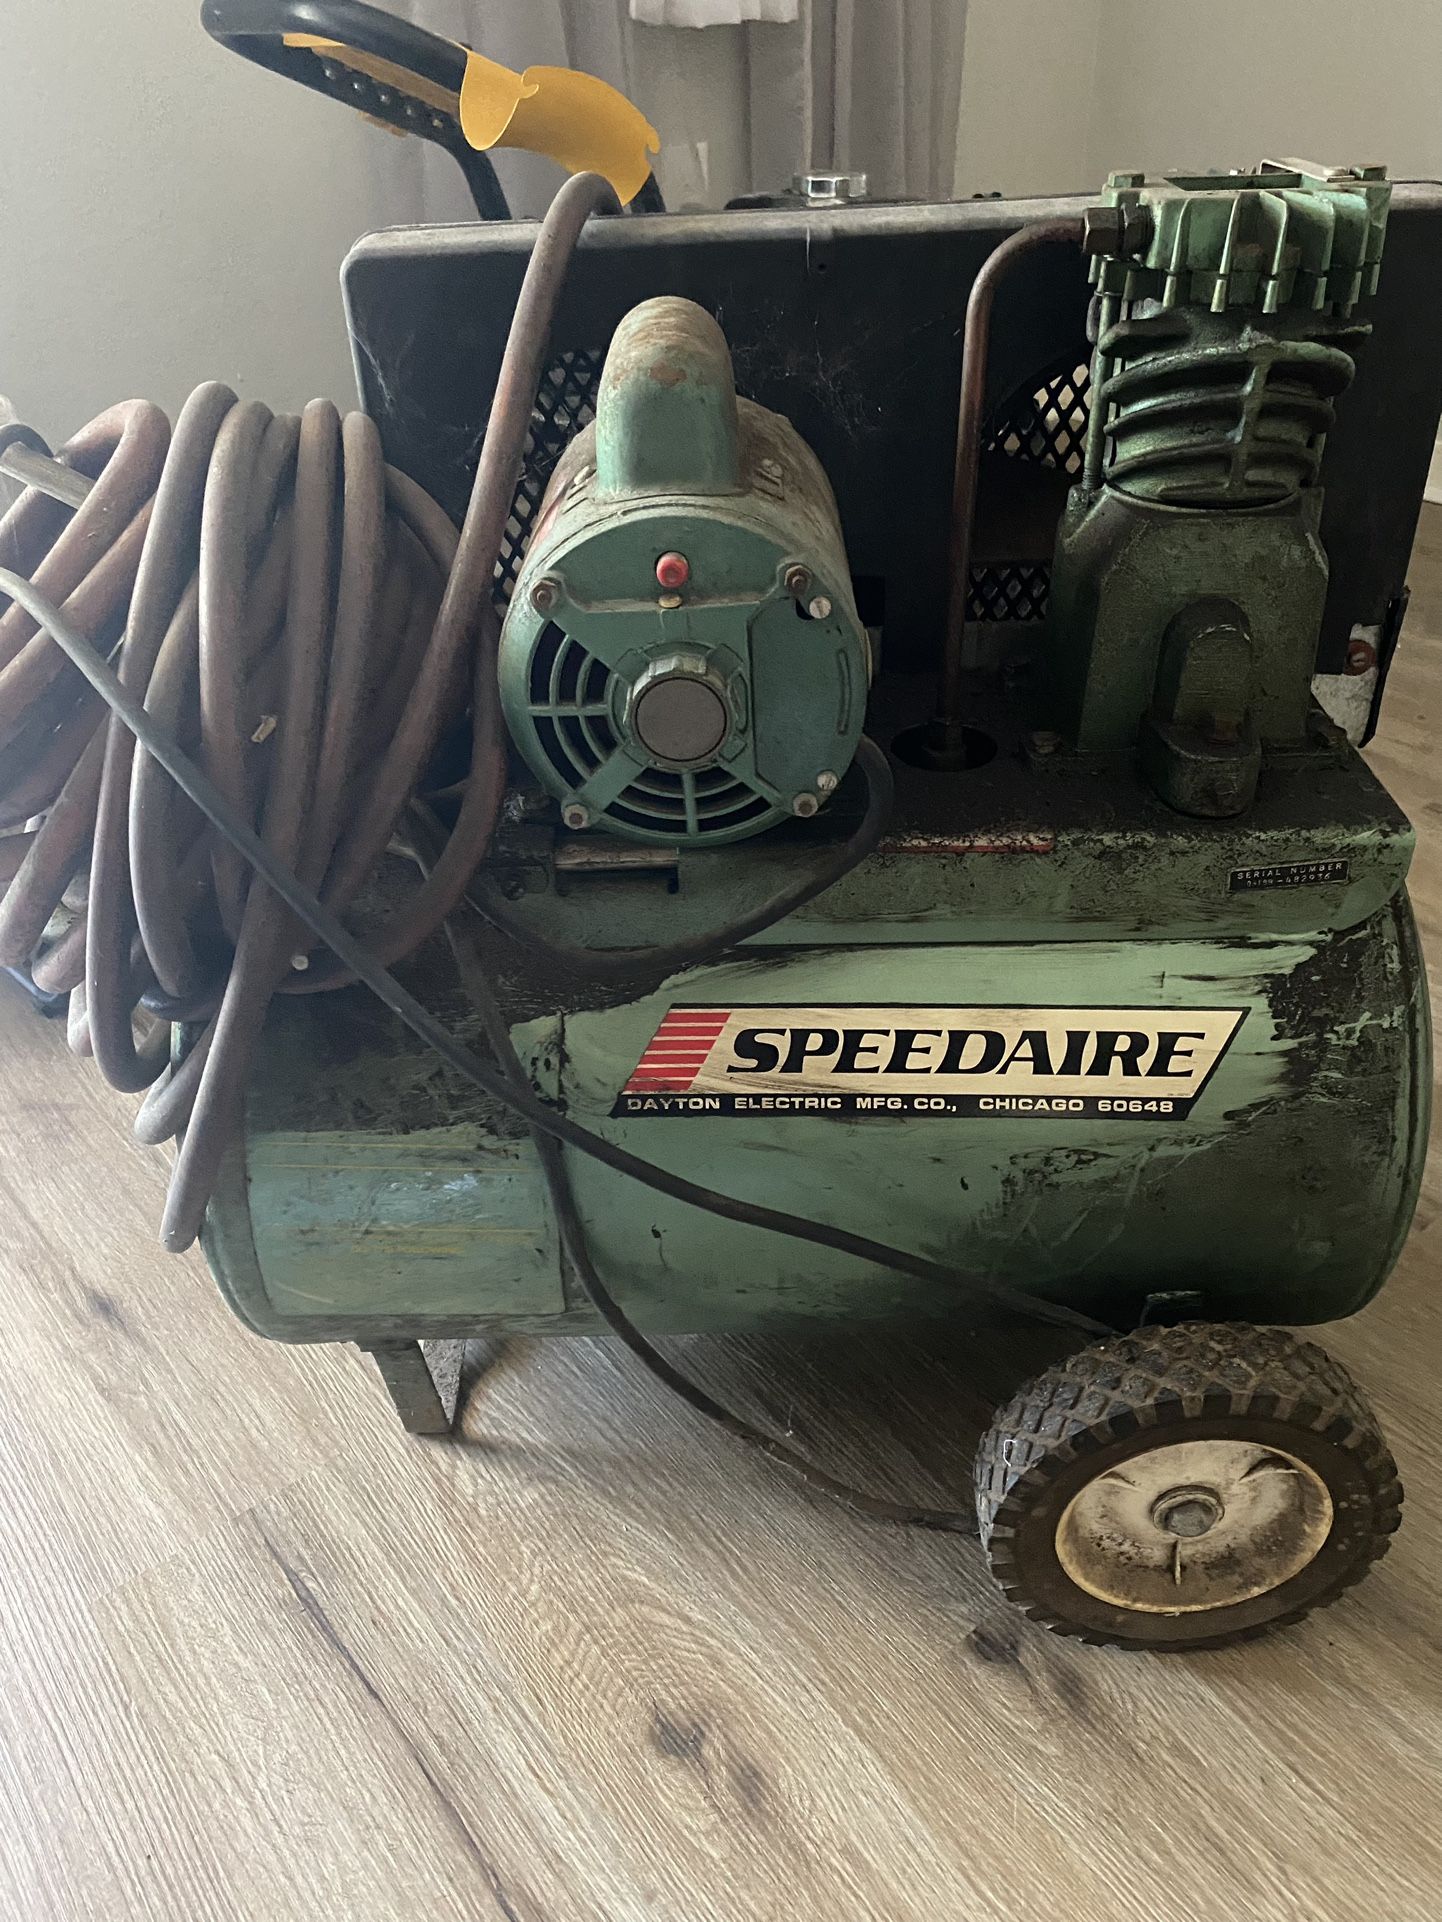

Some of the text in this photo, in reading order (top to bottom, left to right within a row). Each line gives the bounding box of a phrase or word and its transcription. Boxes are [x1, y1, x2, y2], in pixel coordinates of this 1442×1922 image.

[1237, 863, 1342, 880] SERIAL NUMBER
[726, 1028, 1205, 1077] SPEEDAIRE
[627, 1097, 720, 1110] DAYTON
[734, 1097, 842, 1110] ELECTRIC
[979, 1098, 1084, 1111] CHICAGO
[1098, 1099, 1174, 1112] 60648
